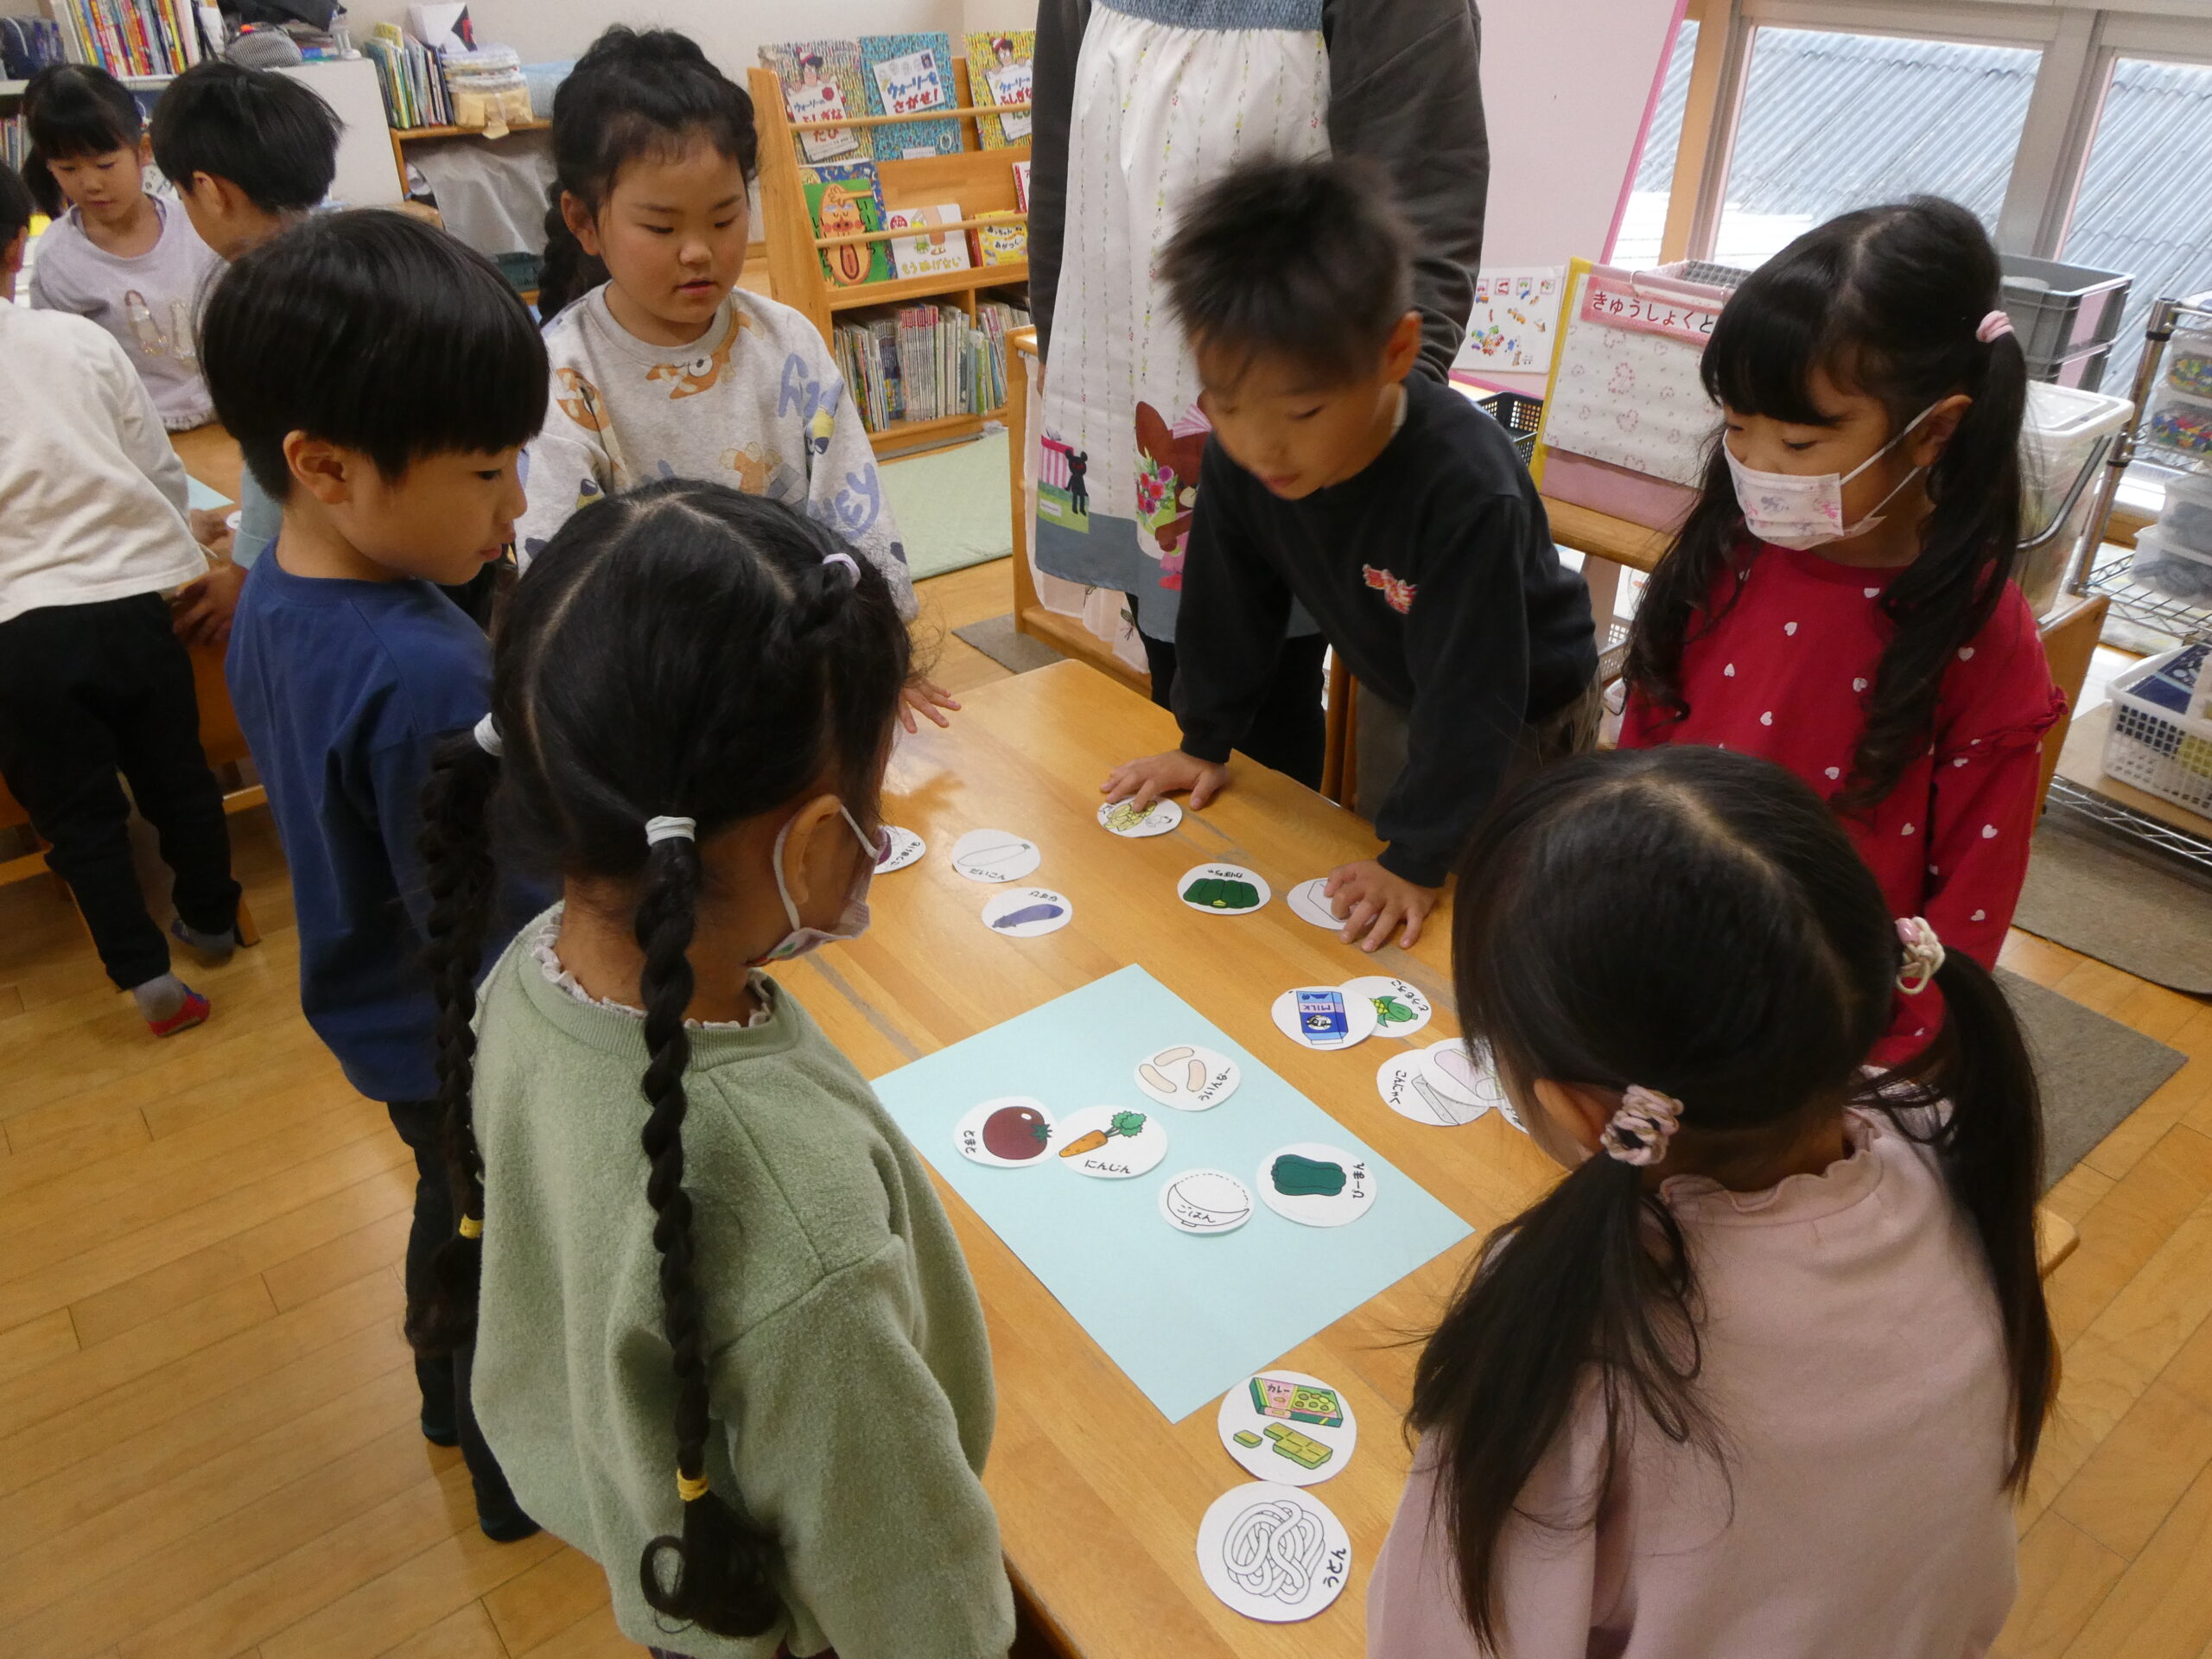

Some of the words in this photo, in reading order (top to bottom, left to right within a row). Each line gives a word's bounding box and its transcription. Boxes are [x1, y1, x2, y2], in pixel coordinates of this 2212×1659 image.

[1389, 1070, 1407, 1104] こんにゃく
[963, 1129, 977, 1154] とまと
[1084, 1159, 1131, 1174] にんじん
[1176, 1205, 1217, 1223] ごはん
[1268, 1383, 1291, 1394] カレー
